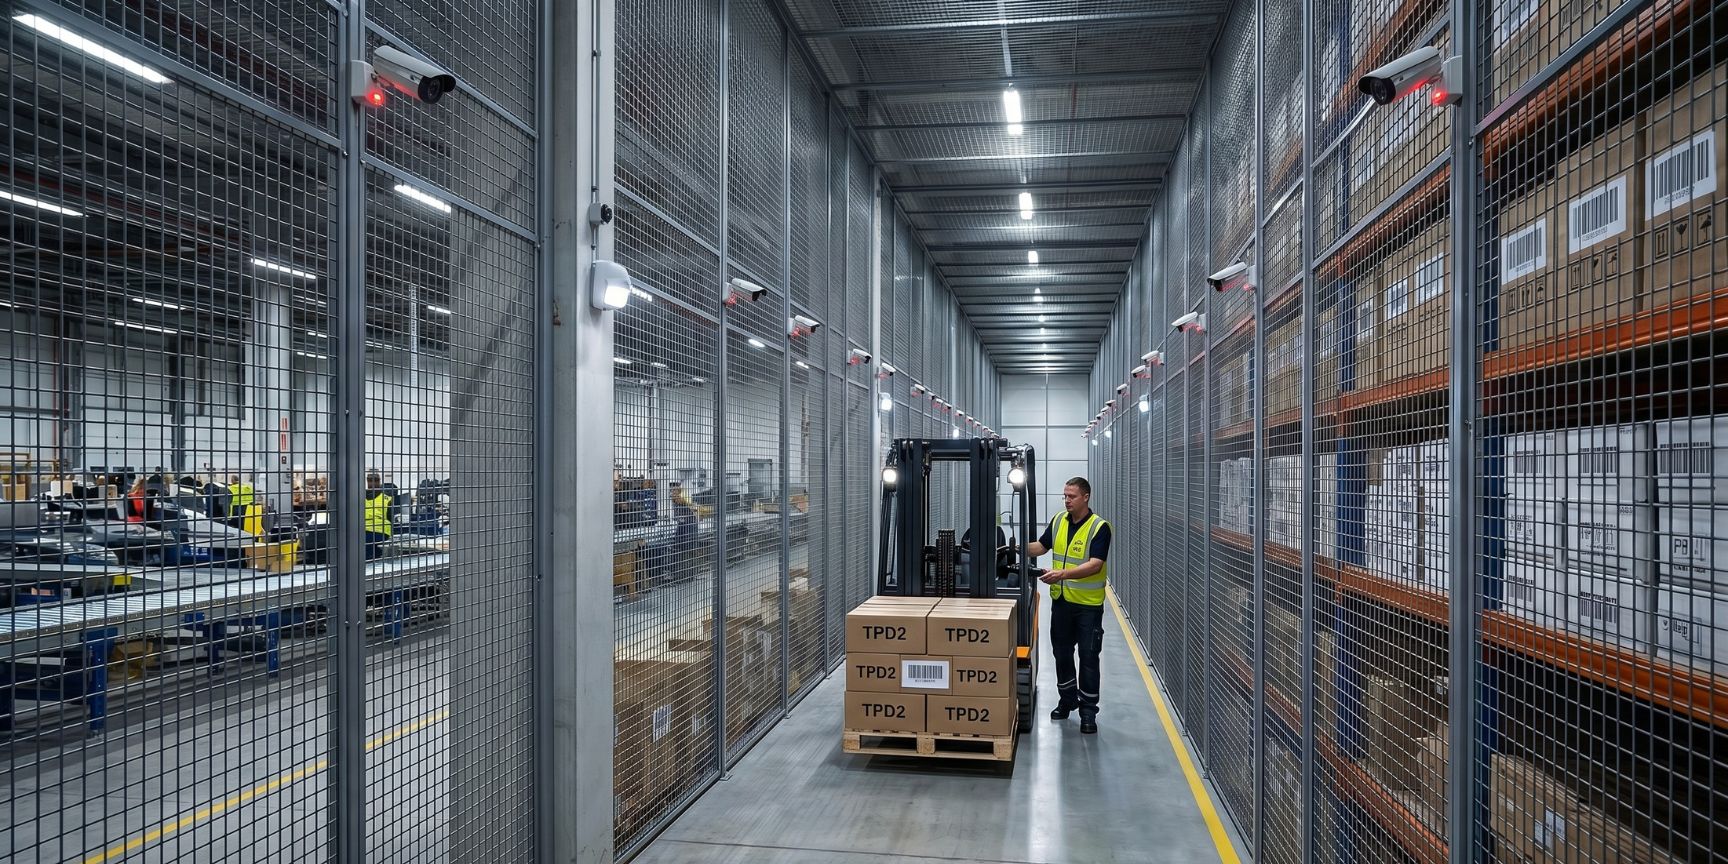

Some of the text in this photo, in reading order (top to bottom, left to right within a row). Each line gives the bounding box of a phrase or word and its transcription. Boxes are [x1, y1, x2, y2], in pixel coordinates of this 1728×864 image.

[862, 626, 907, 641] TPD2
[945, 628, 990, 643] TPD2
[856, 665, 896, 679] TPD2
[957, 669, 997, 683] TPD2
[862, 703, 906, 718] TPD2
[945, 707, 990, 722] TPD2
